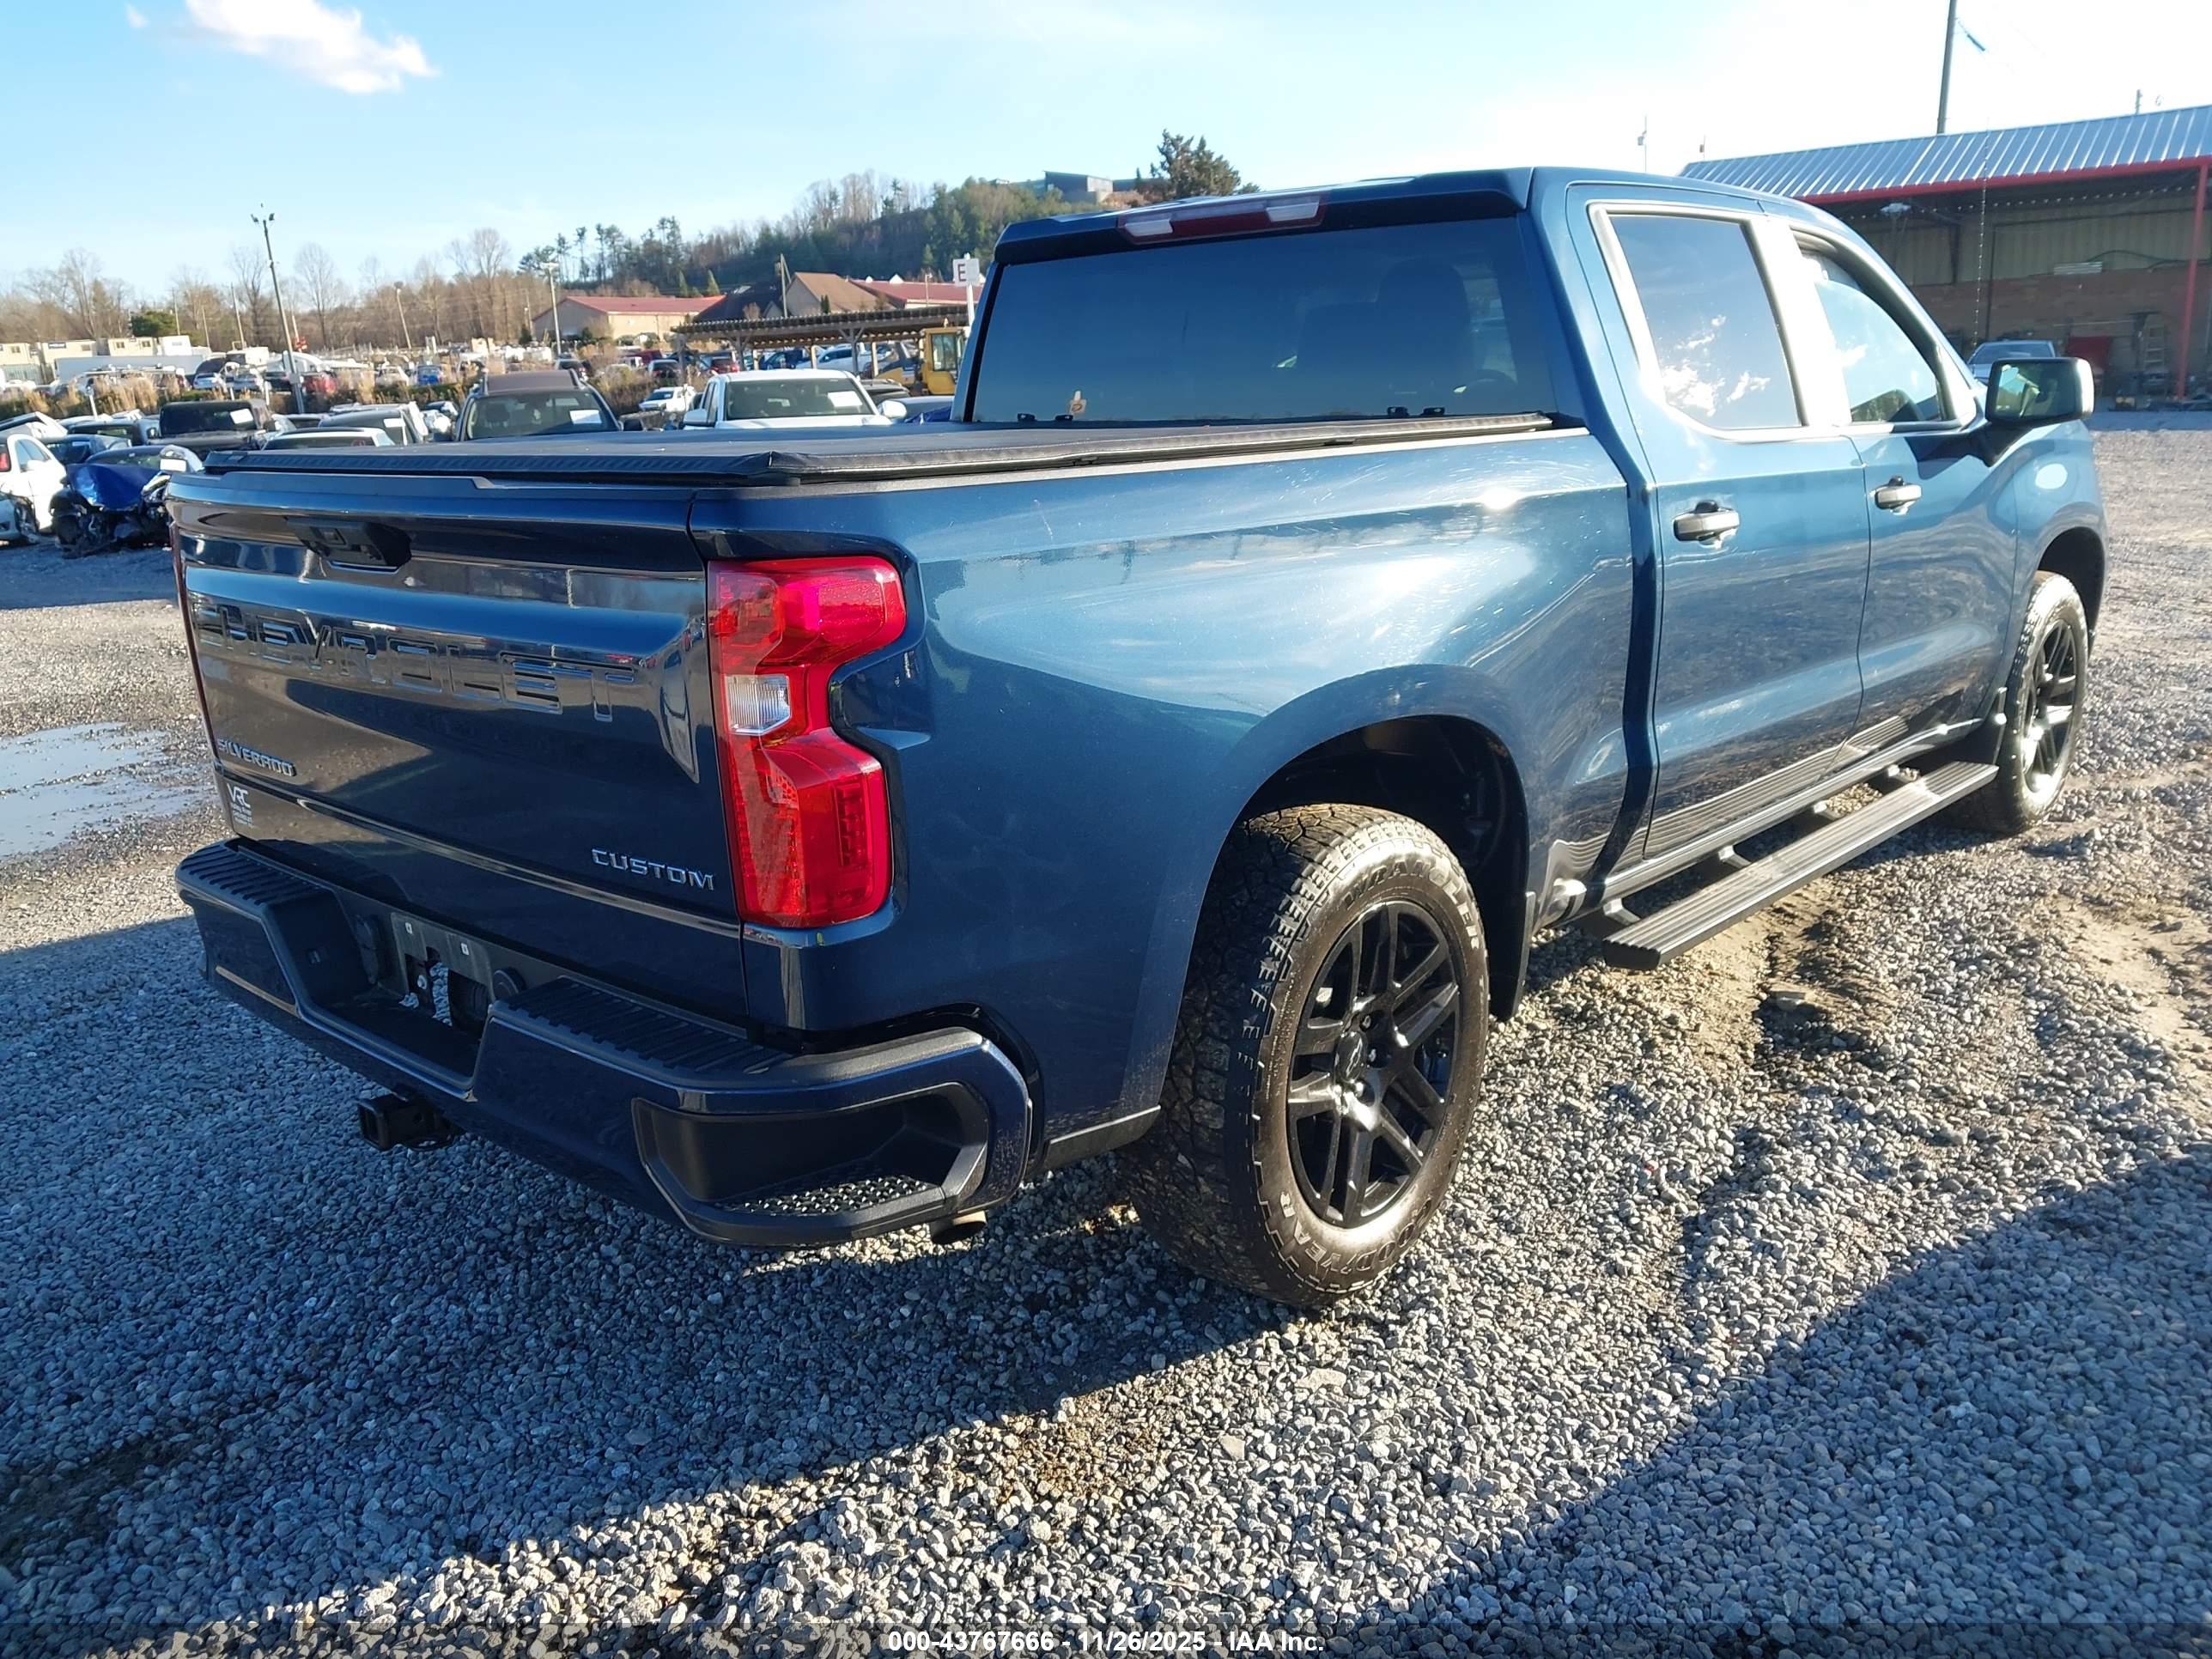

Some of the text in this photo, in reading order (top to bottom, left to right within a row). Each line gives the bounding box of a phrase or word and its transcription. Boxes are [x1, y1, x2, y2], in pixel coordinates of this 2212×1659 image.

[957, 263, 967, 283] E
[194, 603, 635, 722] CHEVROLET
[218, 738, 294, 777] SILVERADO
[591, 848, 714, 891] CUSTOM
[1342, 857, 1480, 950] WRANGLER
[1279, 1191, 1431, 1274] GOODYEAR
